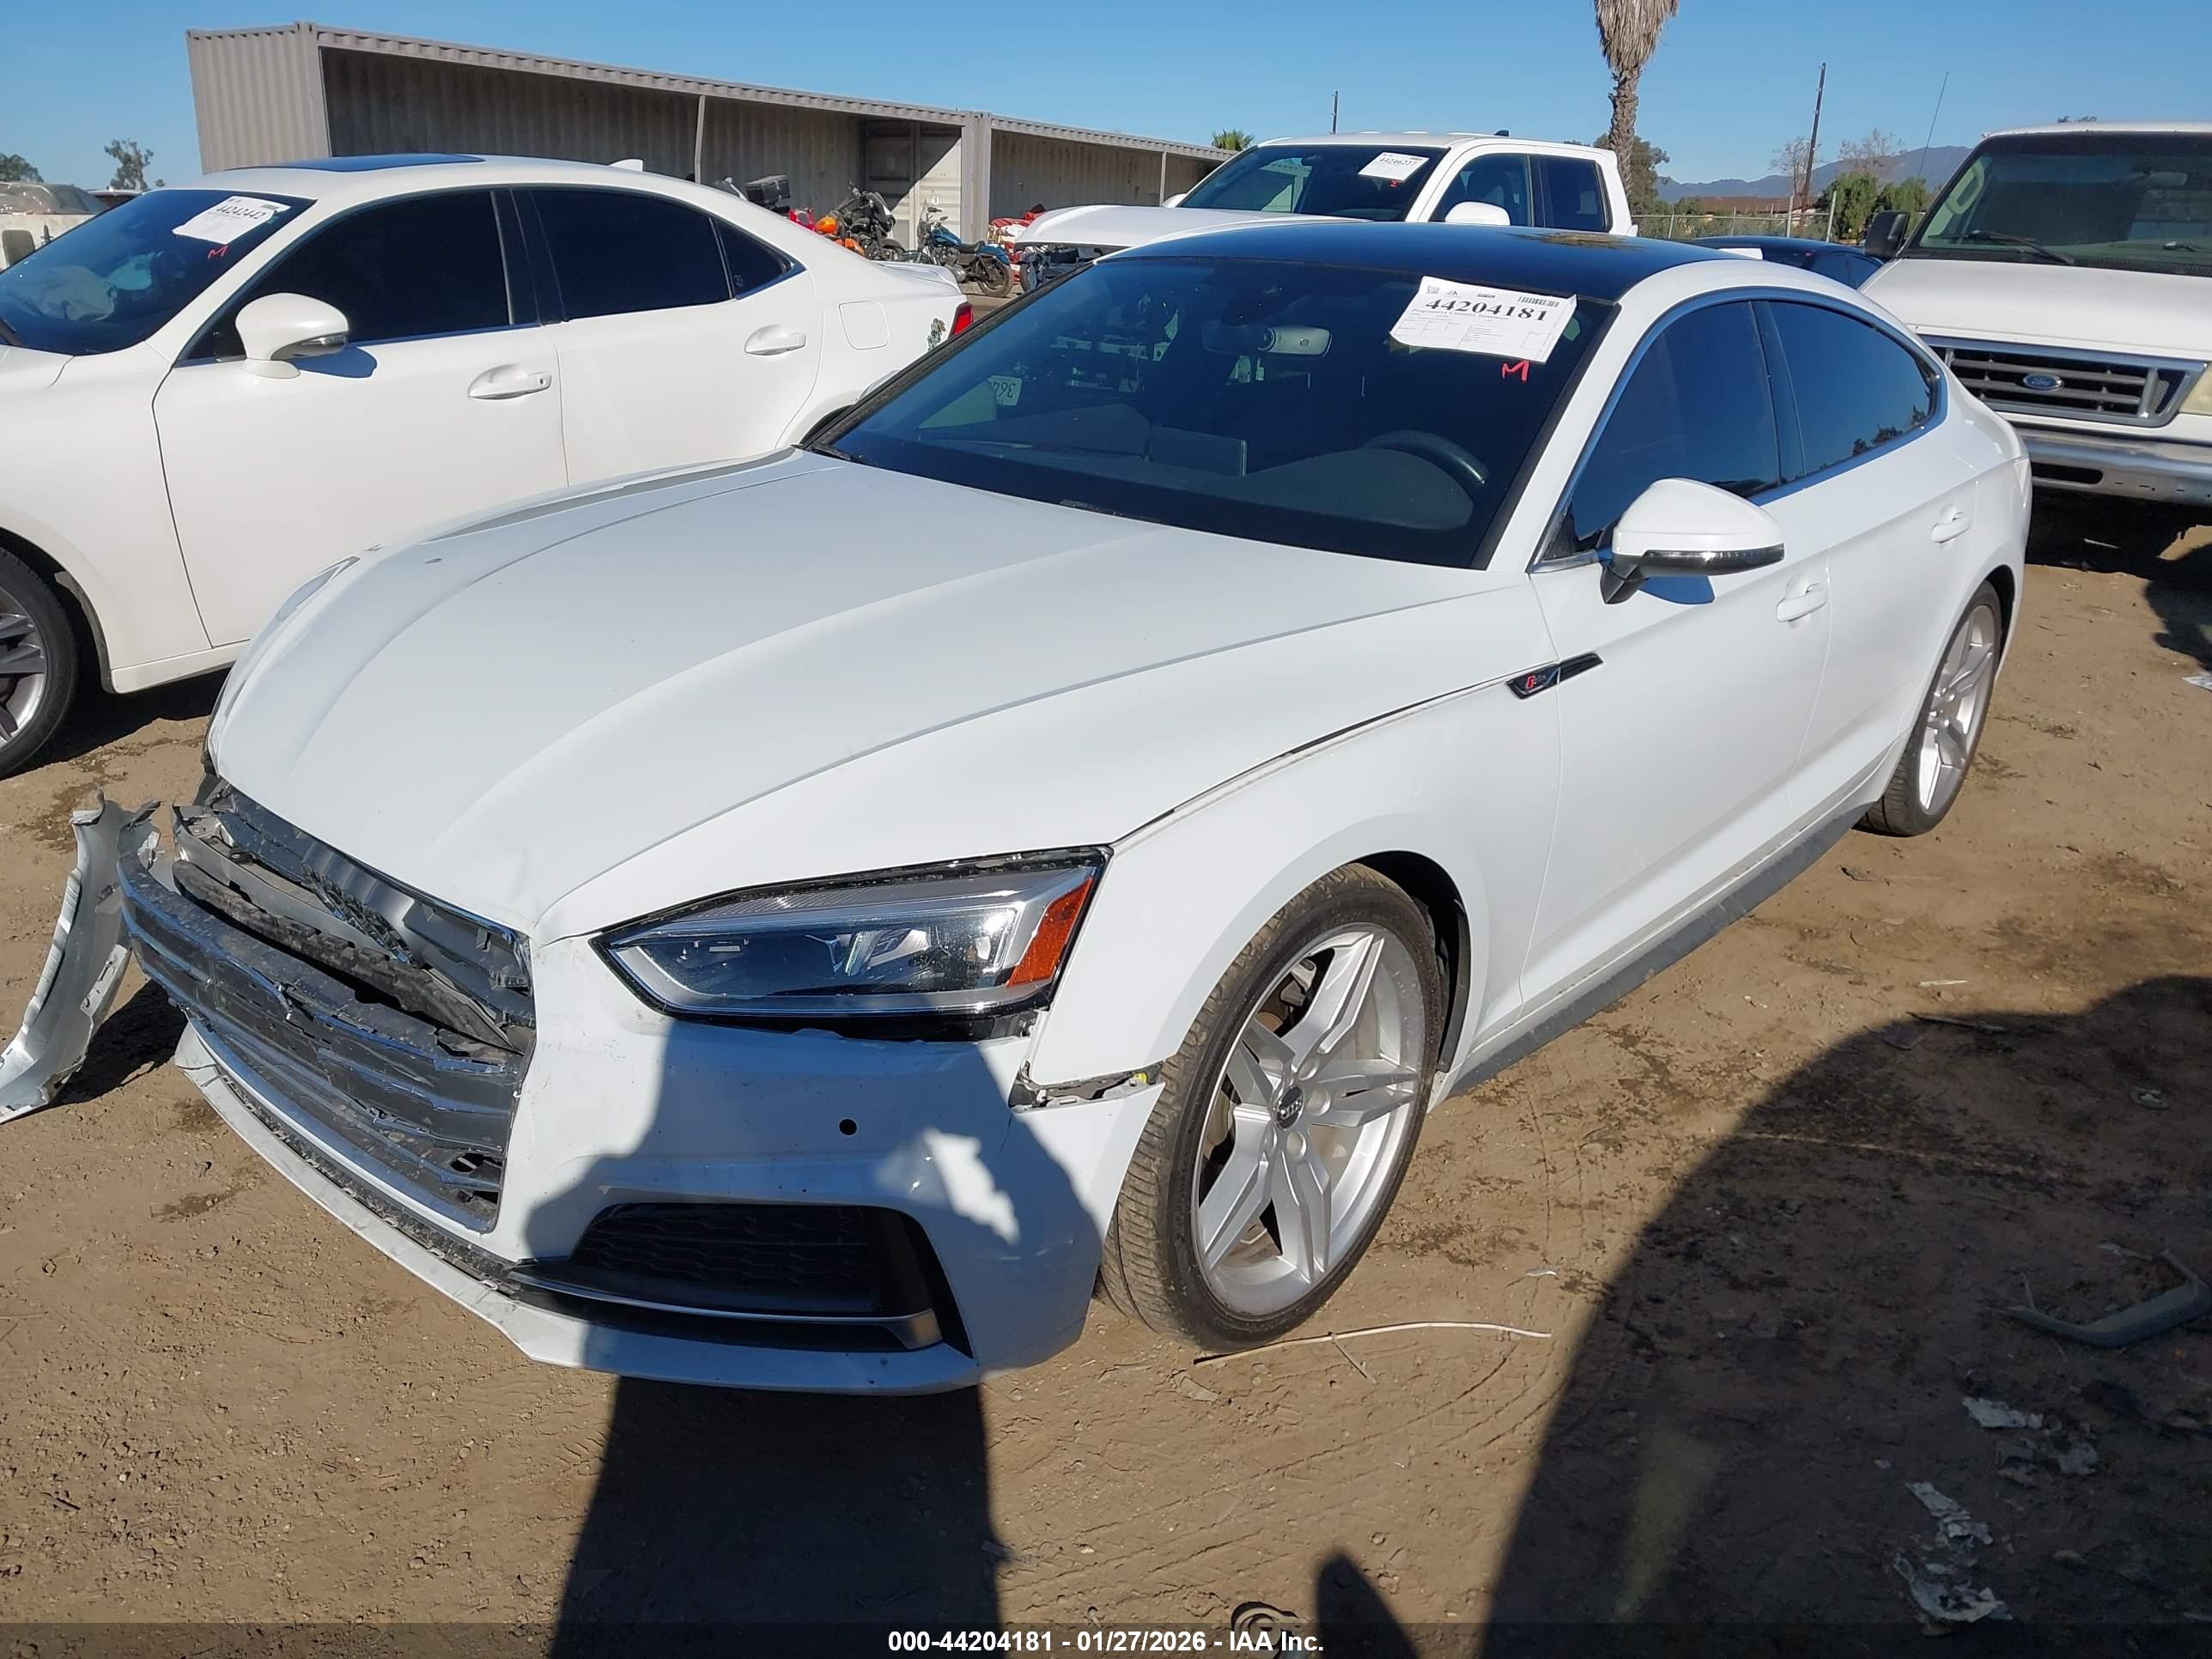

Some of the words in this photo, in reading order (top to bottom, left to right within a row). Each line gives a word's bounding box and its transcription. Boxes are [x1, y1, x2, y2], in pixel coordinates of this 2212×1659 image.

[208, 245, 228, 259] M
[1425, 299, 1547, 321] 44204181
[1502, 361, 1530, 381] M
